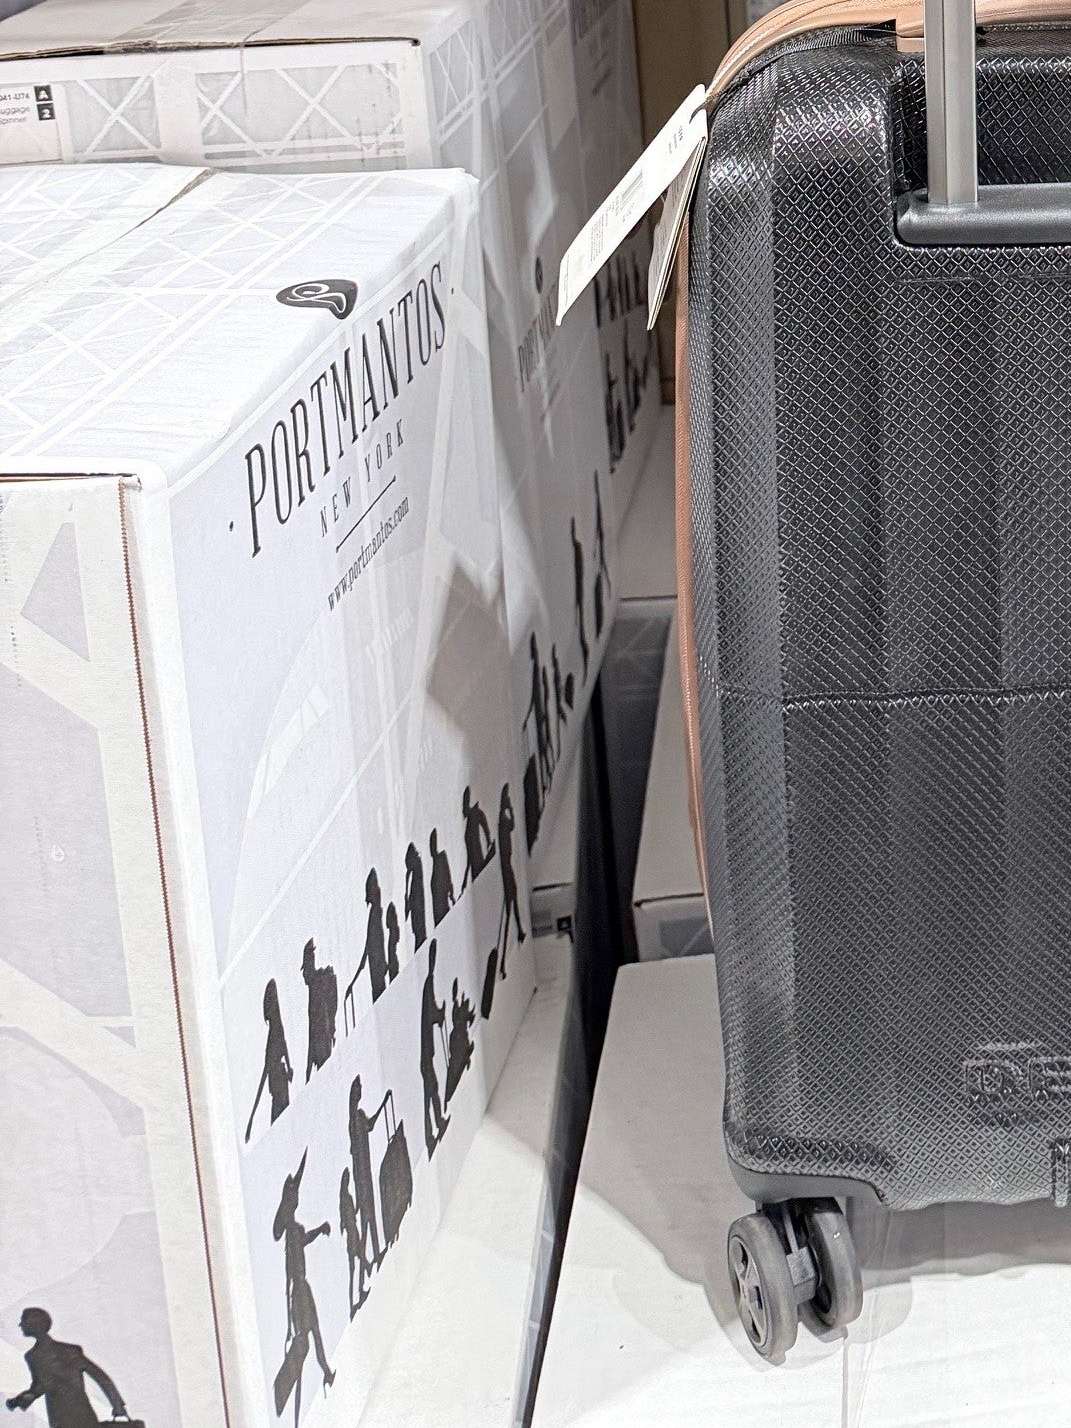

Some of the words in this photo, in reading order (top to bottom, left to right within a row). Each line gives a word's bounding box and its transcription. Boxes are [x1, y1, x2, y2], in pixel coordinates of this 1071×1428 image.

[245, 261, 445, 558] PORTMANTOS
[320, 477, 352, 538] NEW
[364, 419, 404, 483] YORK
[328, 497, 409, 611] www.portmantos.com
